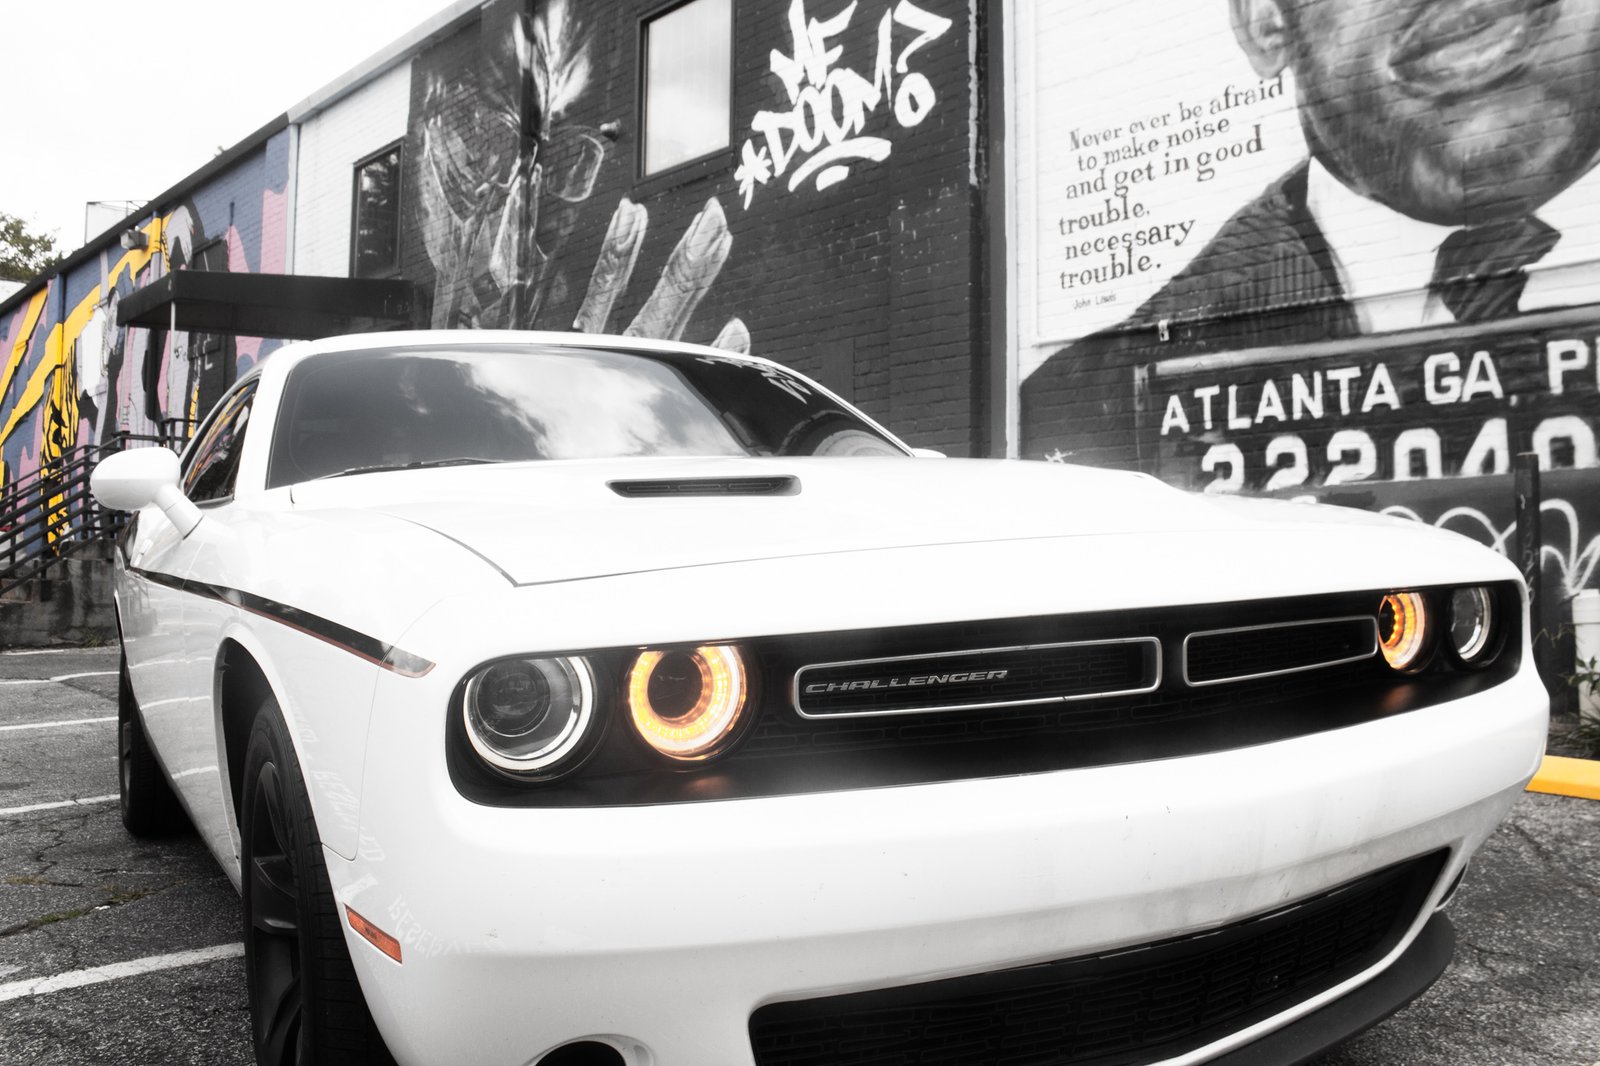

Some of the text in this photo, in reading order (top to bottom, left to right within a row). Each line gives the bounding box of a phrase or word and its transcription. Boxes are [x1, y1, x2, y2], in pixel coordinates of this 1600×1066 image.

[1069, 74, 1285, 152] Never ever be afraid
[1066, 124, 1266, 199] and get in good
[1077, 117, 1230, 172] to make noise
[1065, 219, 1196, 260] necessary
[1060, 248, 1162, 289] trouble.
[1160, 363, 1401, 435] ATLANTA
[805, 670, 1008, 694] CHALLENGER
